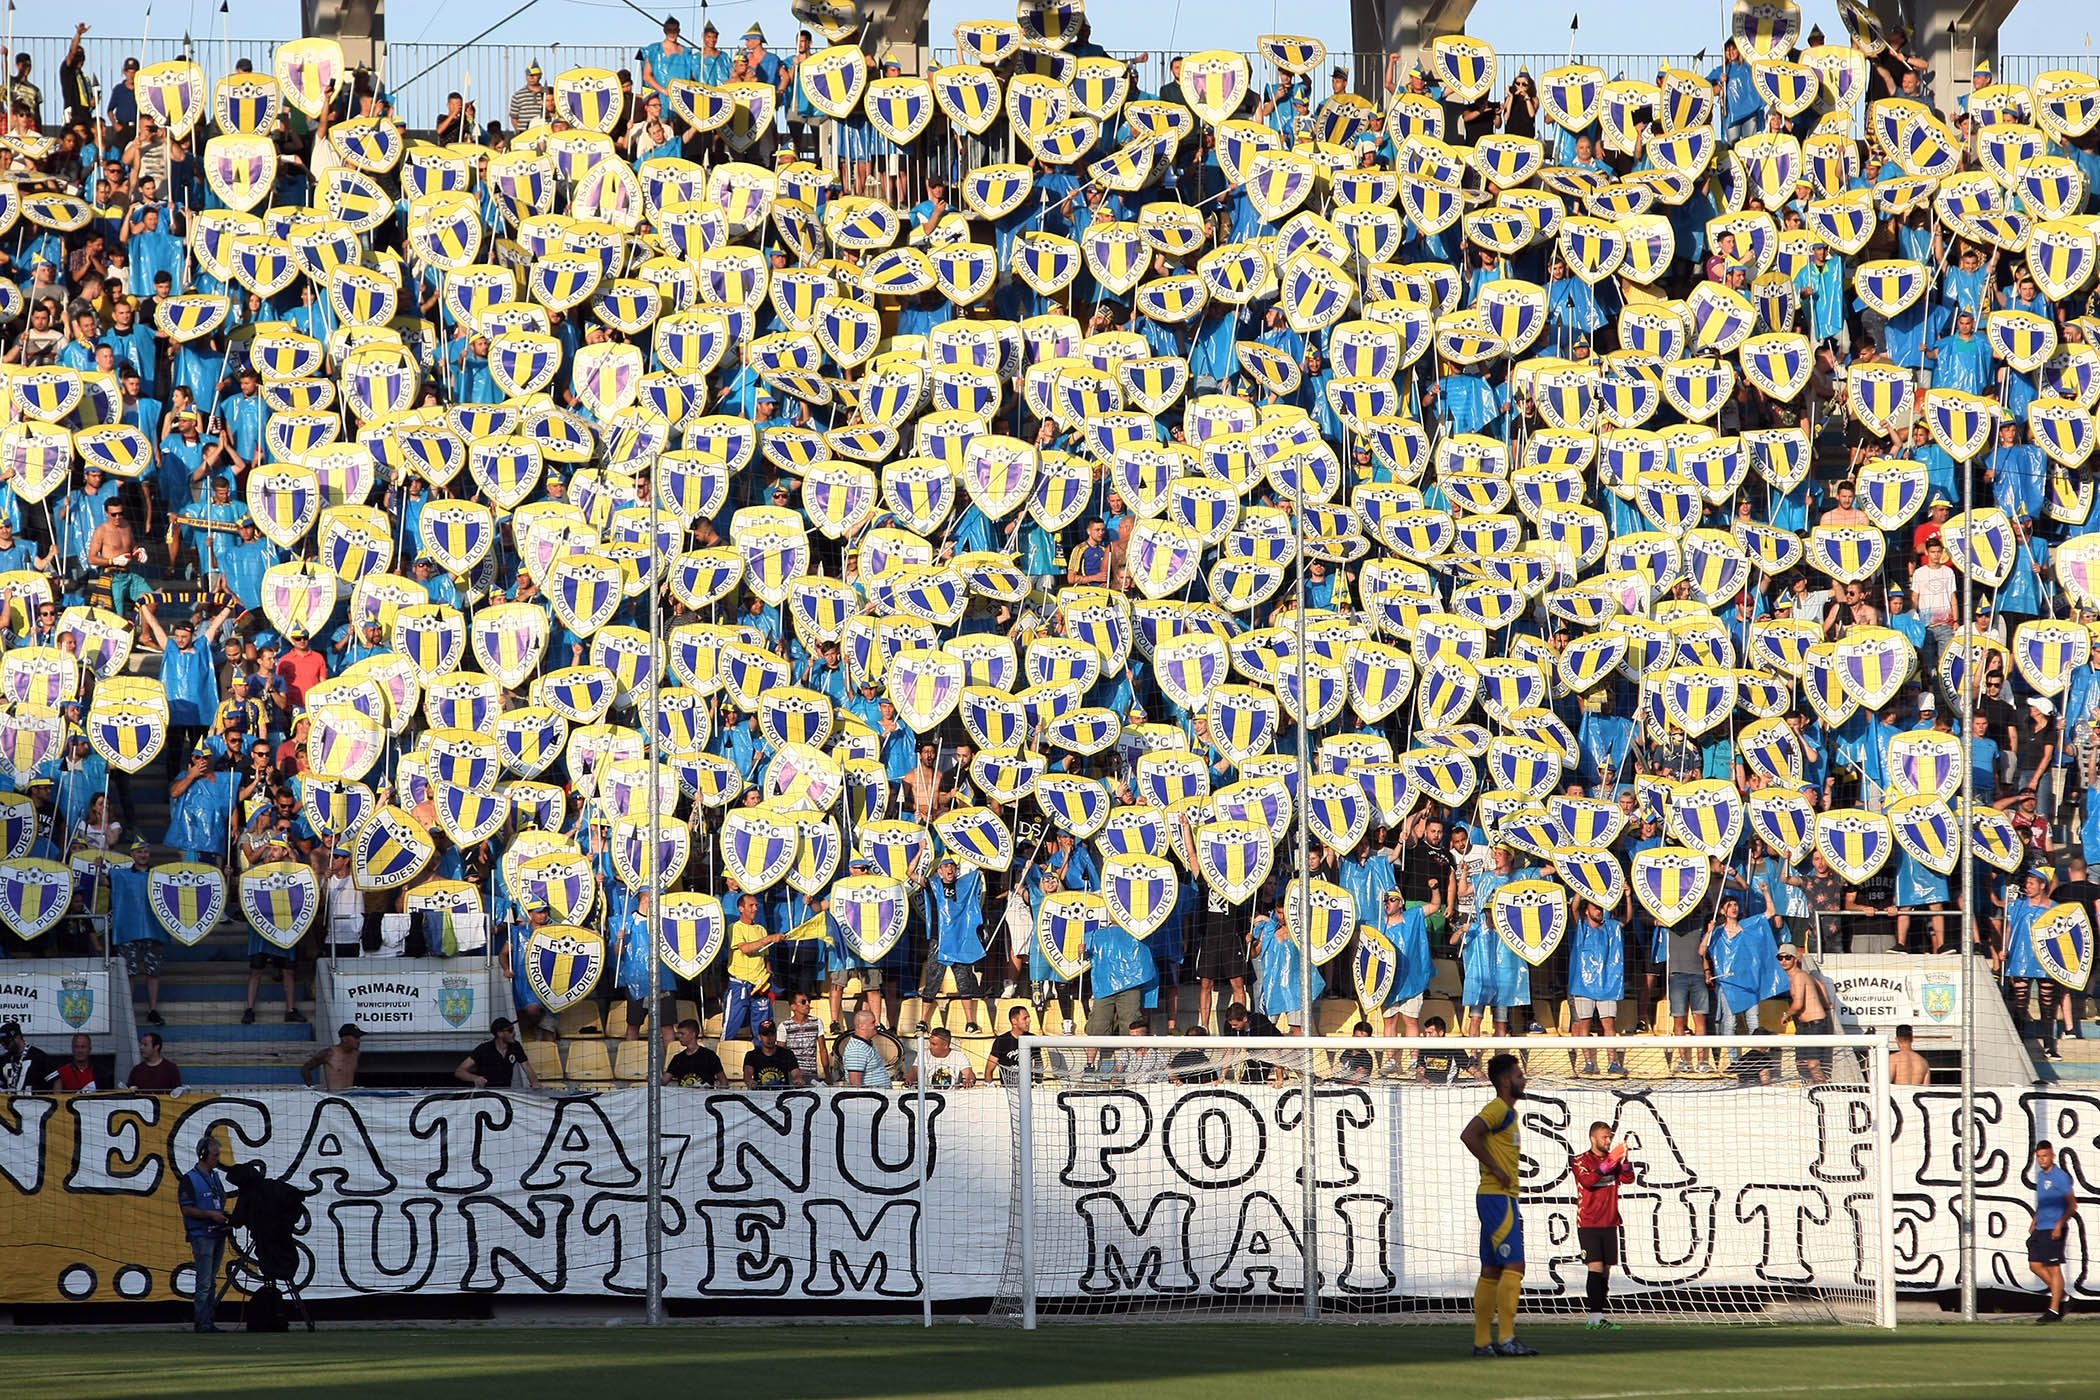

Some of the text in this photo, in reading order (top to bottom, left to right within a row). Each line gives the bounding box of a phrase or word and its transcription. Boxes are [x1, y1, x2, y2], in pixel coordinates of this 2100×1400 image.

[804, 58, 862, 112] PETROLUL PLOIESTI
[1436, 50, 1492, 92] PETROLUL PLOIESTI
[868, 95, 928, 136] PETROLUL PLOIESTI
[937, 81, 996, 124] PETROLUL PLOIESTI
[1543, 81, 1603, 124] PETROLUL PLOIESTI
[1479, 145, 1539, 180] PETROLUL PLOIESTI
[1903, 118, 1956, 176] PETROLUL PLOIESTI
[968, 178, 1029, 211] PETROLUL PLOIESTI
[2017, 175, 2078, 216] PETROLUL PLOIESTI
[232, 250, 295, 289] PETROLUL PLOIESTI
[1016, 245, 1077, 287] PETROLUL PLOIESTI
[2031, 238, 2092, 290] PETROLUL PLOIESTI
[334, 277, 393, 329] PETROLUL PLOIESTI
[1286, 264, 1347, 326] PETROLUL PLOIESTI
[1859, 273, 1921, 309] PETROLUL PLOIESTI
[818, 310, 876, 360] PETROLUL PLOIESTI
[1666, 374, 1730, 413] PETROLUL PLOIESTI
[1744, 348, 1807, 393] PETROLUL PLOIESTI
[1368, 428, 1425, 473] PETROLUL PLOIESTI
[1928, 403, 1986, 451] PETROLUL PLOIESTI
[2032, 416, 2091, 459] PETROLUL PLOIESTI
[473, 453, 537, 497] PETROLUL PLOIESTI
[807, 477, 871, 529] PETROLUL PLOIESTI
[1638, 486, 1698, 531] PETROLUL PLOIESTI
[1861, 478, 1924, 523] PETROLUL PLOIESTI
[424, 518, 489, 565] PETROLUL PLOIESTI
[1384, 521, 1449, 557] PETROLUL PLOIESTI
[1815, 538, 1880, 578] PETROLUL PLOIESTI
[554, 573, 619, 627] PETROLUL PLOIESTI
[674, 565, 739, 601] PETROLUL PLOIESTI
[1158, 650, 1223, 704] PETROLUL PLOIESTI
[1345, 656, 1410, 712] PETROLUL PLOIESTI
[1422, 664, 1472, 727] PETROLUL PLOIESTI
[1837, 647, 1903, 701] PETROLUL PLOIESTI
[964, 700, 1023, 753] PETROLUL PLOIESTI
[1667, 681, 1733, 726] PETROLUL PLOIESTI
[91, 723, 160, 764] PETROLUL PLOIESTI
[1213, 701, 1275, 757] PETROLUL PLOIESTI
[1493, 748, 1558, 797] PETROLUL PLOIESTI
[942, 818, 1009, 866] PETROLUL PLOIESTI
[1671, 798, 1738, 855] PETROLUL PLOIESTI
[1819, 826, 1887, 872] PETROLUL PLOIESTI
[1894, 810, 1956, 867] PETROLUL PLOIESTI
[356, 817, 423, 886] PETROLUL PLOIESTI
[726, 824, 794, 883] PETROLUL PLOIESTI
[1201, 841, 1268, 892] PETROLUL PLOIESTI
[1106, 874, 1132, 927] PETROLUL
[1149, 879, 1173, 926] PLOIESTI
[1556, 860, 1621, 901] PETROLUL PLOIESTI
[1637, 864, 1705, 913] PETROLUL PLOIESTI
[38, 884, 68, 928] PLOIESTI
[152, 882, 220, 934] PETROLUL PLOIESTI
[243, 881, 314, 939] PETROLUL PLOIESTI
[1497, 902, 1563, 955] PETROLUL PLOIESTI
[531, 944, 600, 1002] PETROLUL PLOIESTI
[2037, 918, 2091, 984] PETROLUL PLOIESTI
[348, 982, 420, 999] PRIMARIA
[1834, 977, 1903, 993] PRIMARIA
[355, 1012, 413, 1022] PLOIESTI
[1840, 1006, 1897, 1016] PLOIESTI
[705, 1091, 946, 1195] NU
[1057, 1089, 1375, 1189] POT
[1075, 1191, 1397, 1294] MAI
